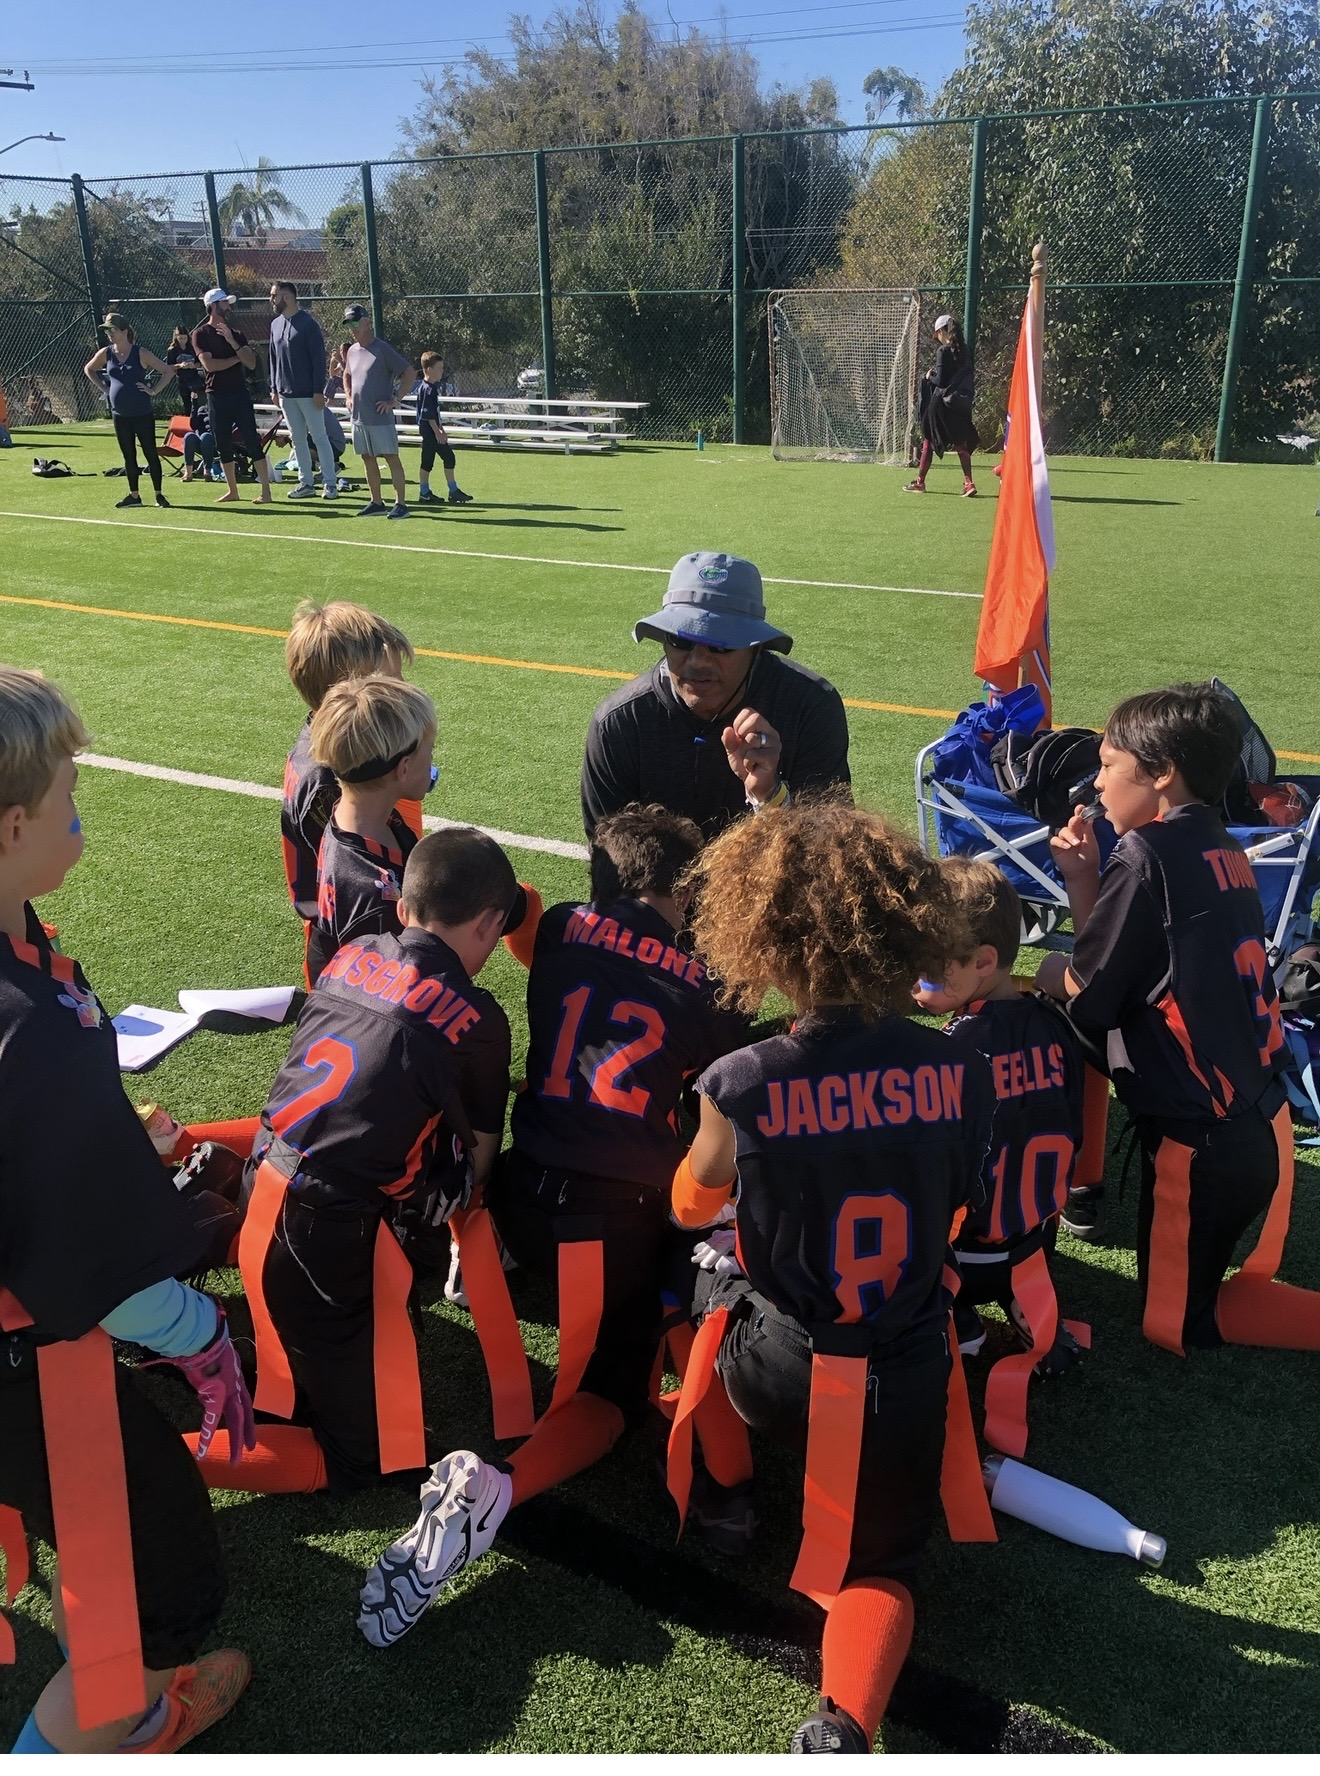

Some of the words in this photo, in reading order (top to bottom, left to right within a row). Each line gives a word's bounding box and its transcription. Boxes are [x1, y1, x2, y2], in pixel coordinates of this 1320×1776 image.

[1202, 848, 1258, 891] TUN
[562, 910, 707, 989] MALONE
[267, 1032, 359, 1139] 2
[540, 982, 668, 1122] 12
[755, 1063, 965, 1138] JACKSON
[976, 1131, 1076, 1244] 10
[829, 1188, 913, 1324] 8
